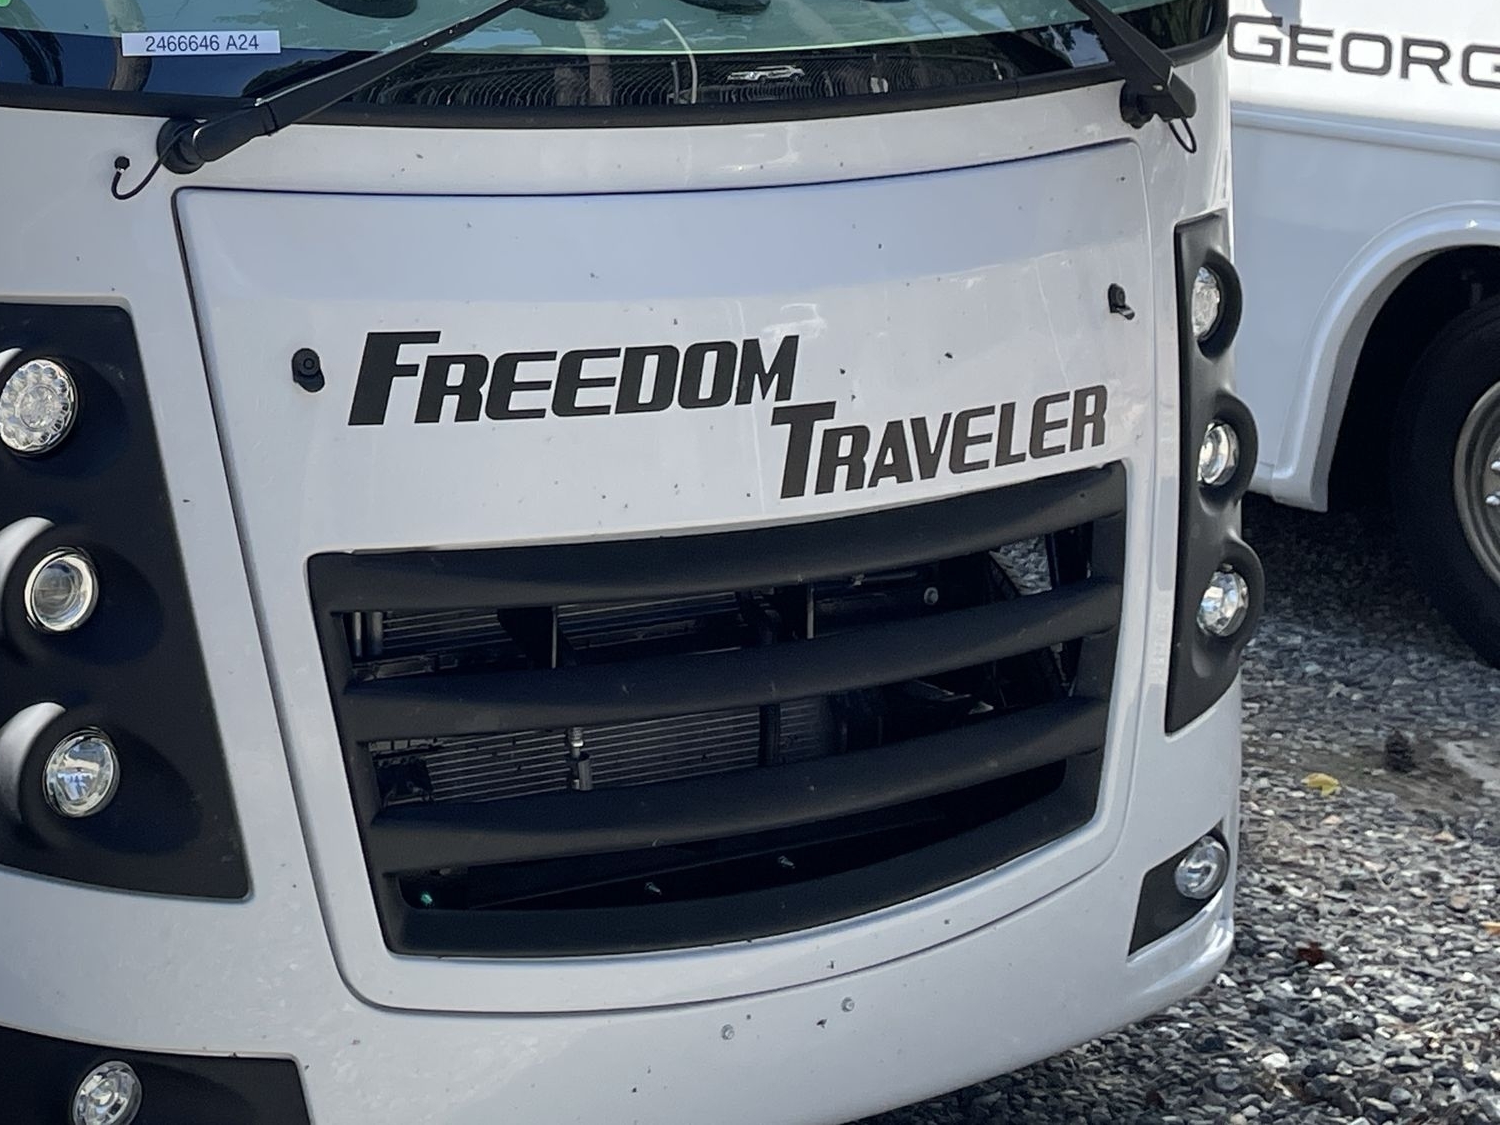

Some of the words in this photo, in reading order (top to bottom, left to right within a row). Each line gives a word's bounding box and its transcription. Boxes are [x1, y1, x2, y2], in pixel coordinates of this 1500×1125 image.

[145, 34, 220, 53] 2466646
[226, 33, 259, 52] A24
[348, 330, 799, 425] FREEDOM
[770, 384, 1108, 499] TRAVELER
